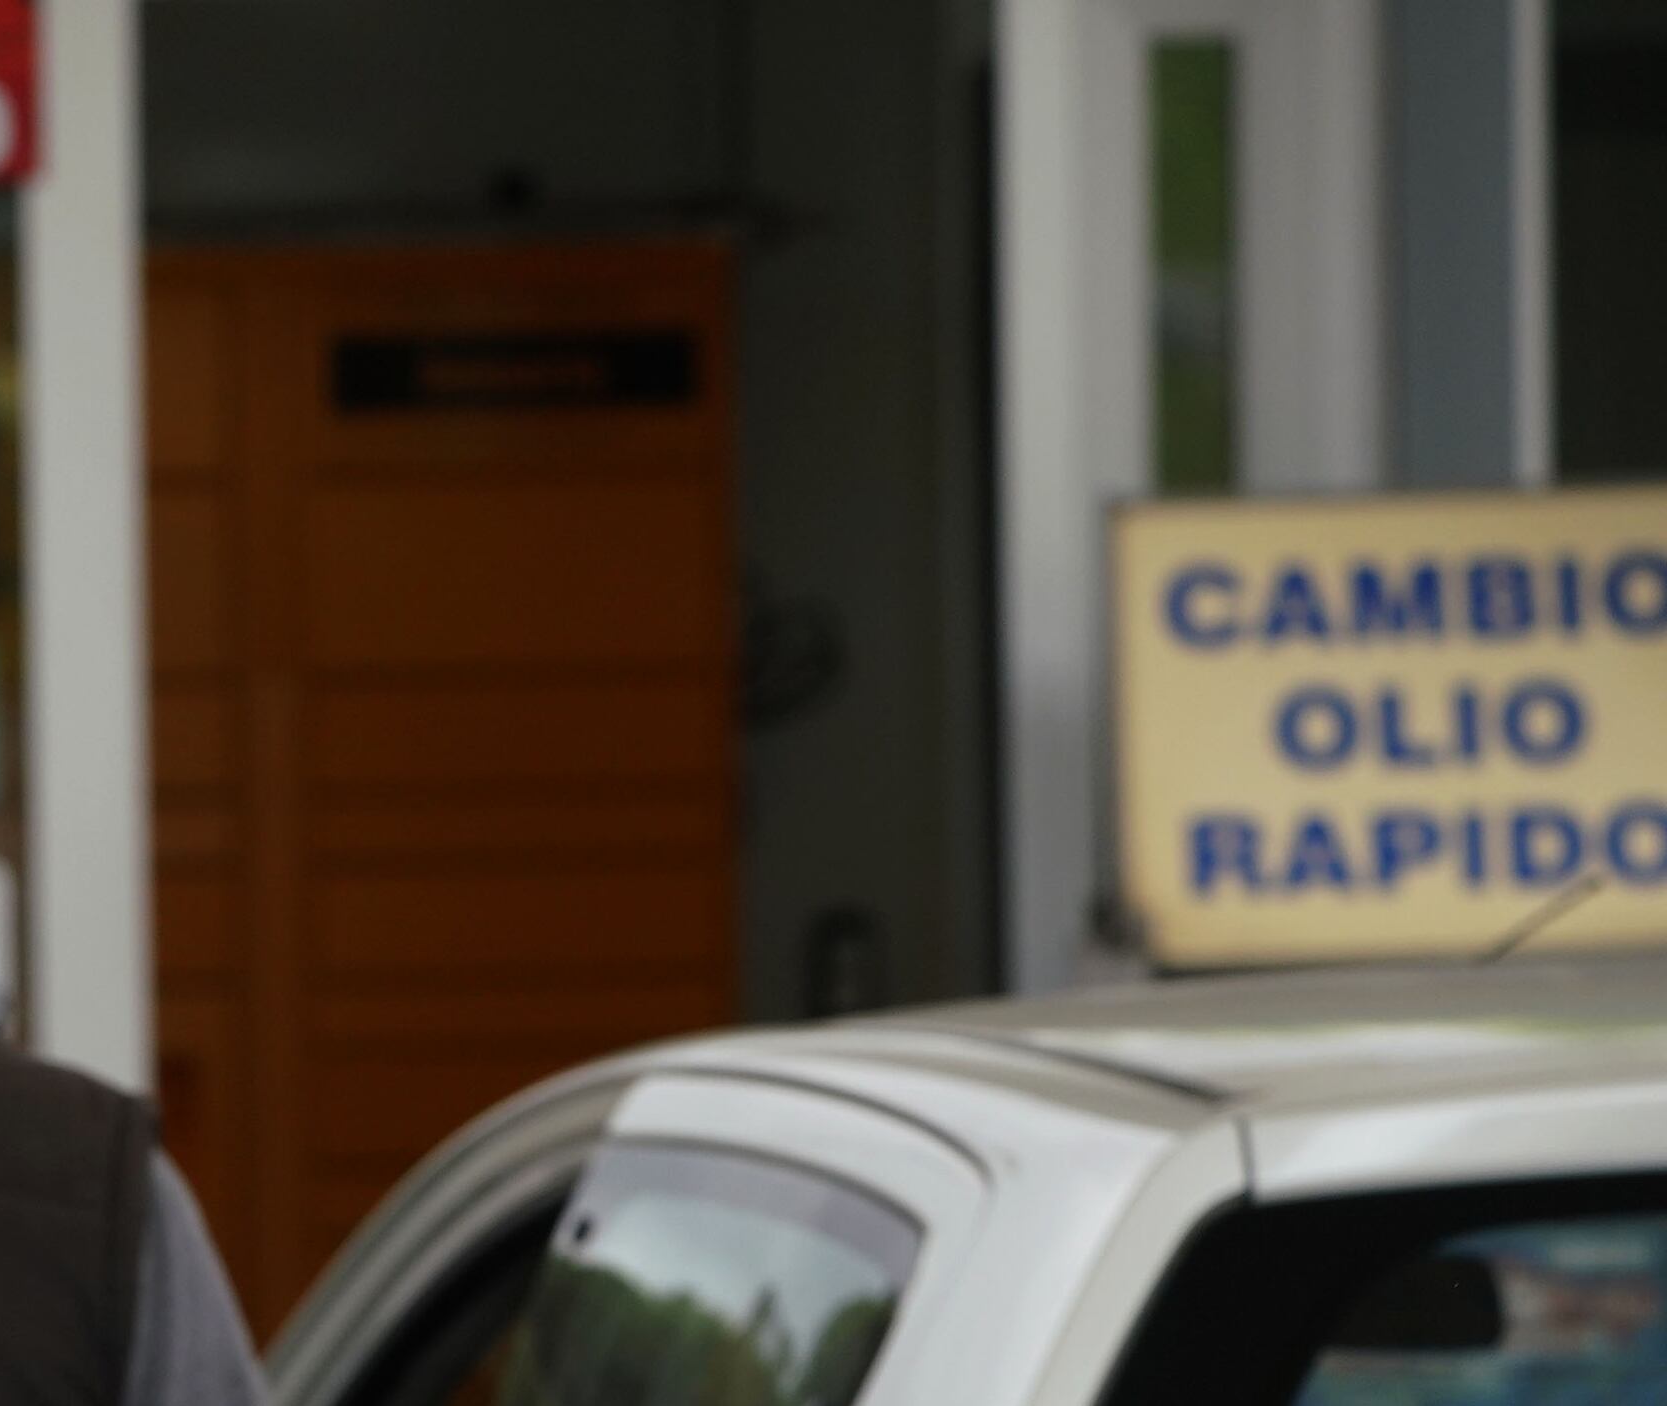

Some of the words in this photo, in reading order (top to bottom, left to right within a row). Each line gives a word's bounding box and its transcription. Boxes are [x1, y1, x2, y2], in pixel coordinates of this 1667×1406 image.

[1162, 547, 1667, 656] CAMBIO
[1274, 675, 1588, 775] OLIO
[1188, 801, 1667, 896] RAPIDO
